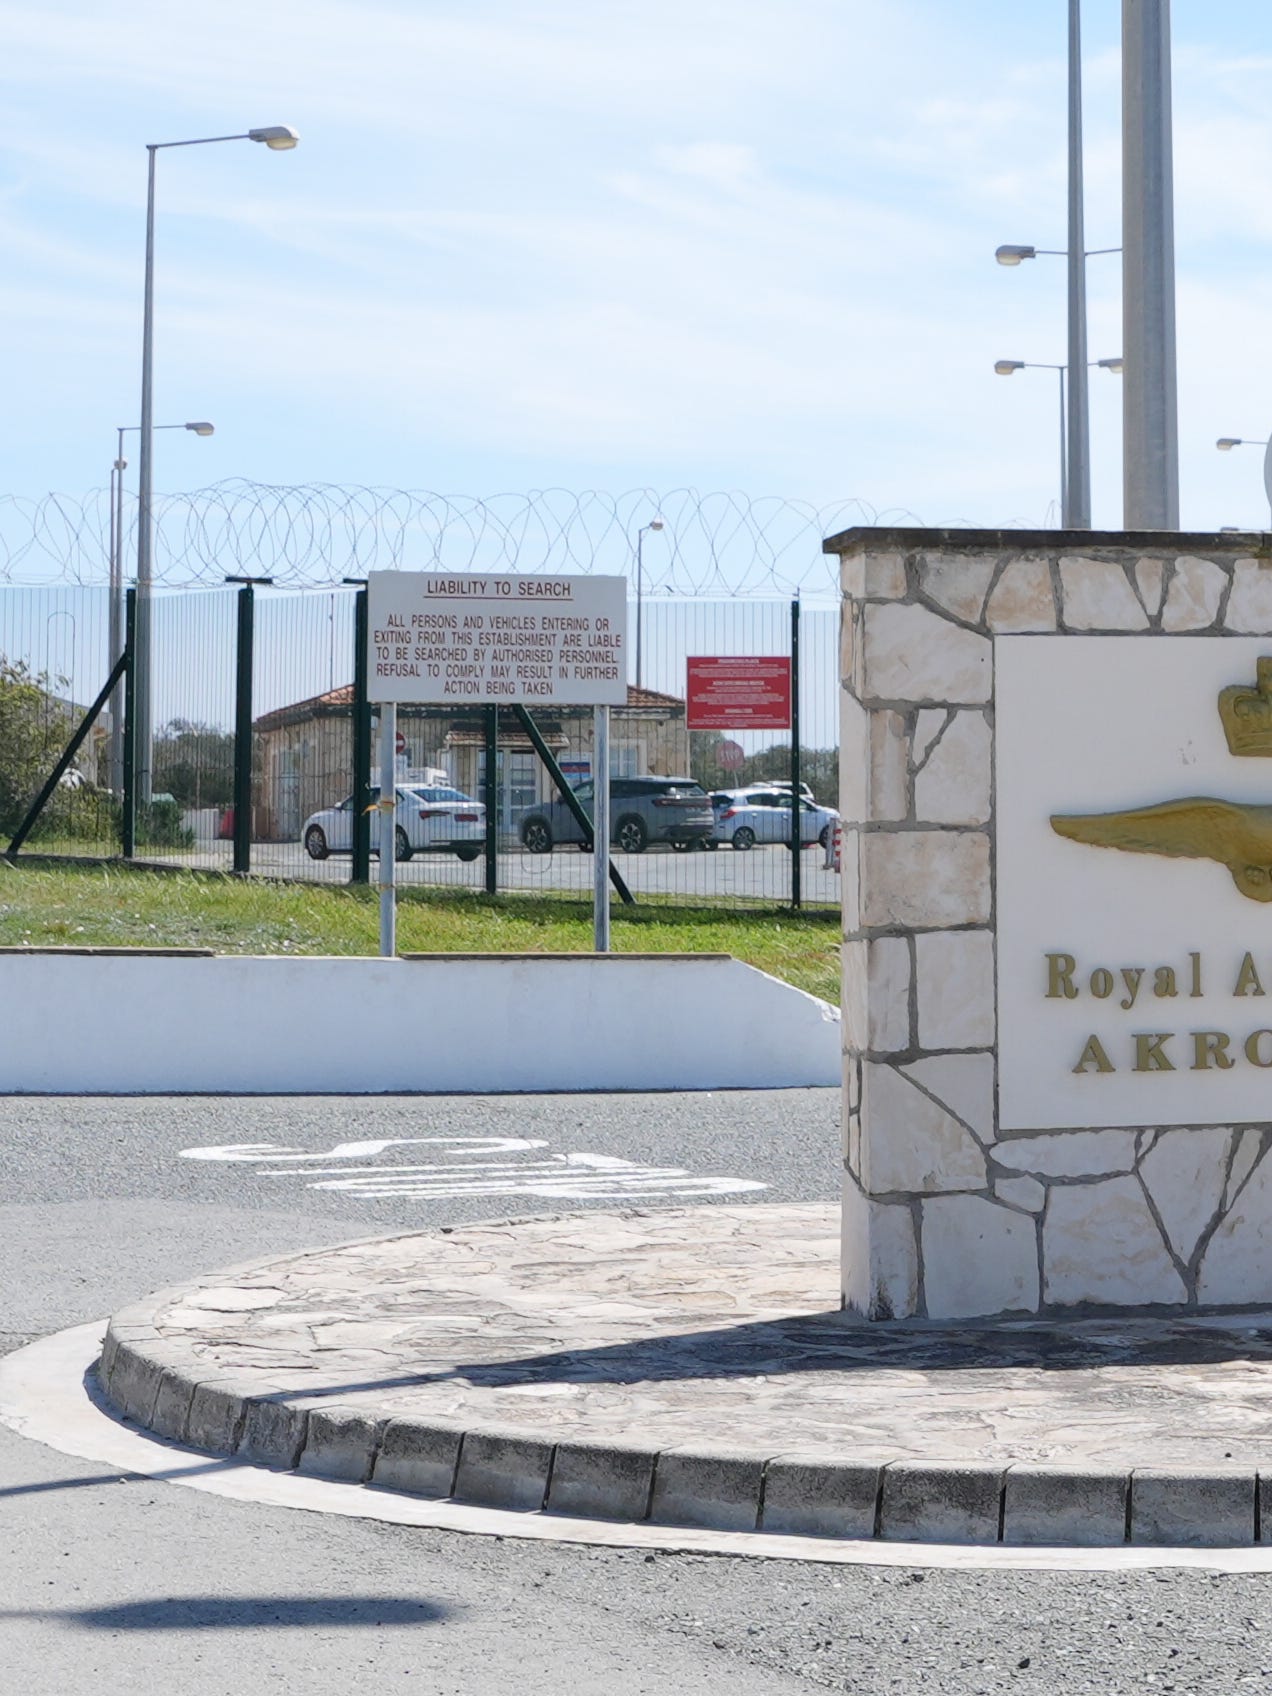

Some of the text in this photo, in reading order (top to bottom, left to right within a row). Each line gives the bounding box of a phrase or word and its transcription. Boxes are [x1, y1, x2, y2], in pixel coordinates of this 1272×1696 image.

[427, 580, 571, 596] LIABILITY TO SEARCH
[386, 614, 609, 631] ALL PERSONS AND VEHICLES ENTERING OR
[374, 630, 622, 648] EXITING FROM THIS ESTABLISHMENT ARE LIABLE
[376, 647, 390, 660] TO
[395, 647, 409, 660] BE
[414, 647, 468, 661] SEARCHED
[473, 648, 487, 661] BY
[491, 648, 554, 662] AUTHORISED
[376, 664, 619, 680] REFUSAL TO COMPLY MAY RESULT IN FURTHER
[443, 681, 553, 695] ACTION BEING TAKEN
[1045, 953, 1204, 1009] Royal
